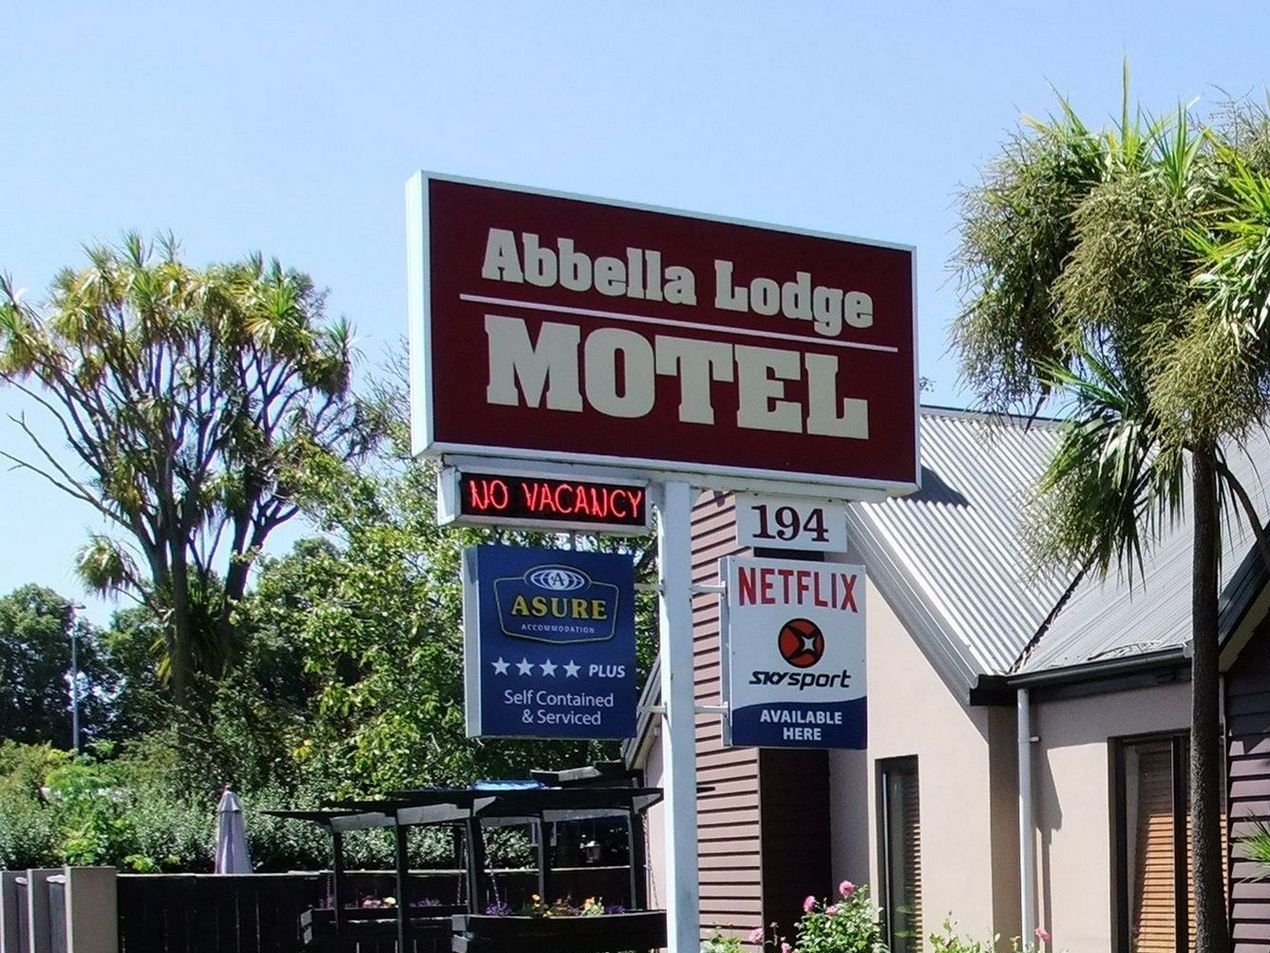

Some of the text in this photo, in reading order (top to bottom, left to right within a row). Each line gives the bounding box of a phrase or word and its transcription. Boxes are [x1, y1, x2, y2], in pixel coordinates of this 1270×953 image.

[481, 227, 874, 337] Abbella Lodge
[484, 314, 869, 439] MOTEL
[469, 479, 642, 519] NO VACANCY
[751, 504, 829, 542] 194
[738, 566, 859, 614] NETFLIX
[511, 595, 608, 620] ASURE
[521, 623, 595, 634] ACCOMMODATION
[589, 664, 626, 679] PLUS
[504, 689, 614, 708] Self Contained
[522, 709, 602, 726] & Serviced
[760, 709, 843, 725] AVAILABLE
[783, 727, 822, 741] HERE
